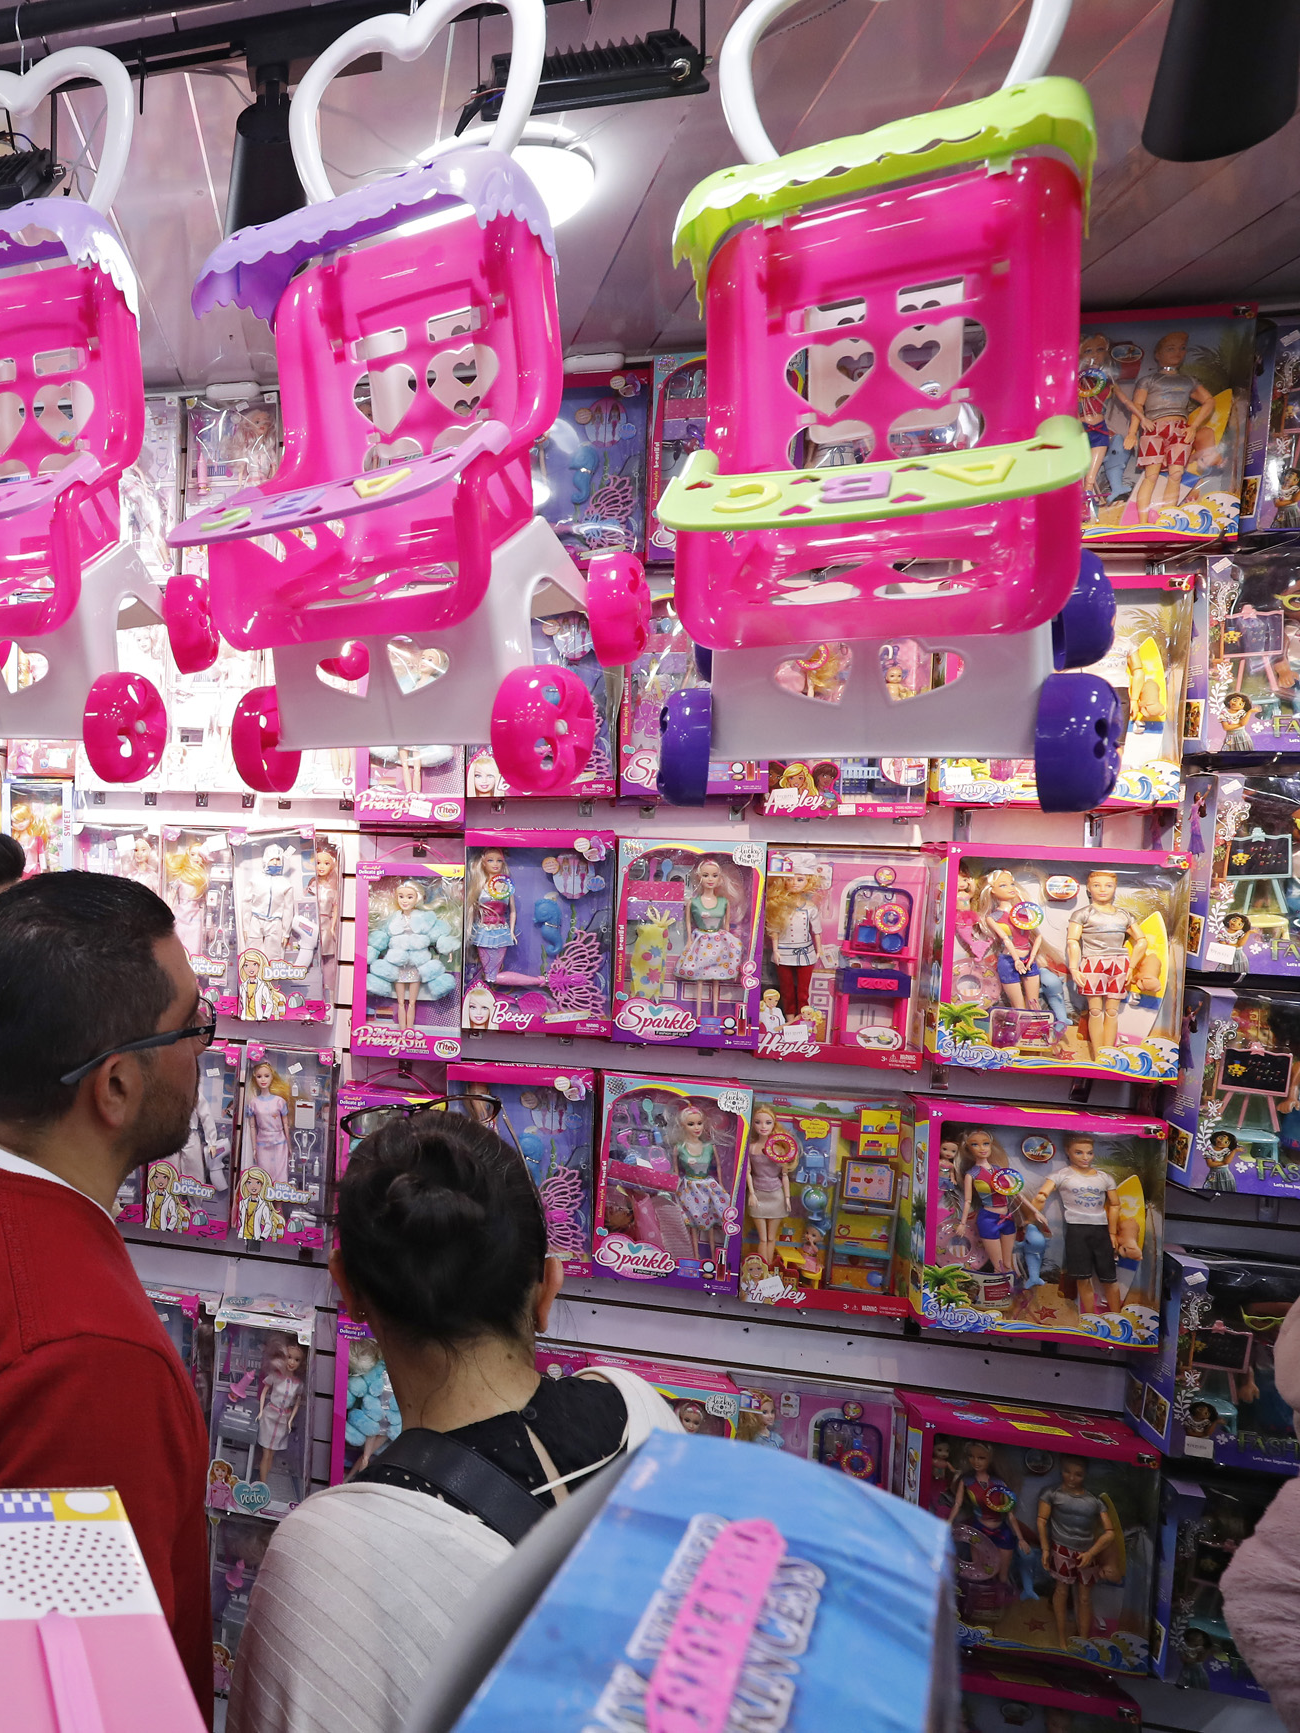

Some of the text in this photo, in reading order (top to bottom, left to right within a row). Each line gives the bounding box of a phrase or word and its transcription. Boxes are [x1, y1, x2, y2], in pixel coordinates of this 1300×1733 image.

[951, 846, 961, 854] 3+
[189, 963, 225, 975] octor
[264, 966, 307, 980] Doctor
[493, 1001, 534, 1030] Betty
[616, 1002, 697, 1035] Sparkle
[600, 1025, 607, 1033] 3+
[758, 1033, 821, 1058] Hayley
[173, 1182, 215, 1198] Doctor
[266, 1187, 311, 1203] Doctor
[595, 1240, 676, 1274] Sparkle
[925, 1421, 936, 1429] 3+
[240, 1491, 267, 1504] Doctor
